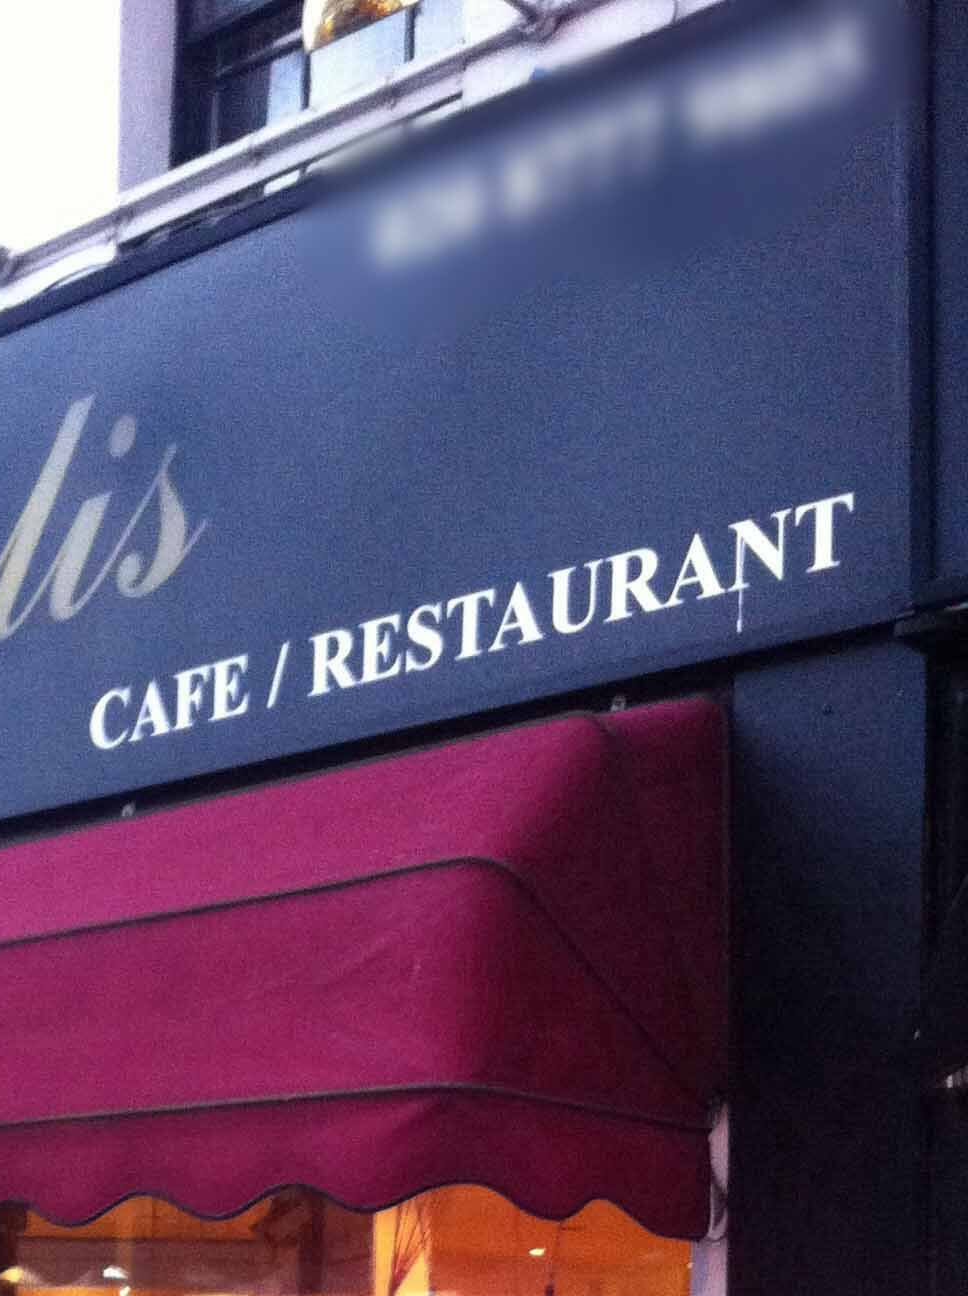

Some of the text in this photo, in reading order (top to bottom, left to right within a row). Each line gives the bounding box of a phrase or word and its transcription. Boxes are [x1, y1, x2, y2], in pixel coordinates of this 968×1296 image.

[88, 492, 856, 751] CAFE / RESTAURANT
